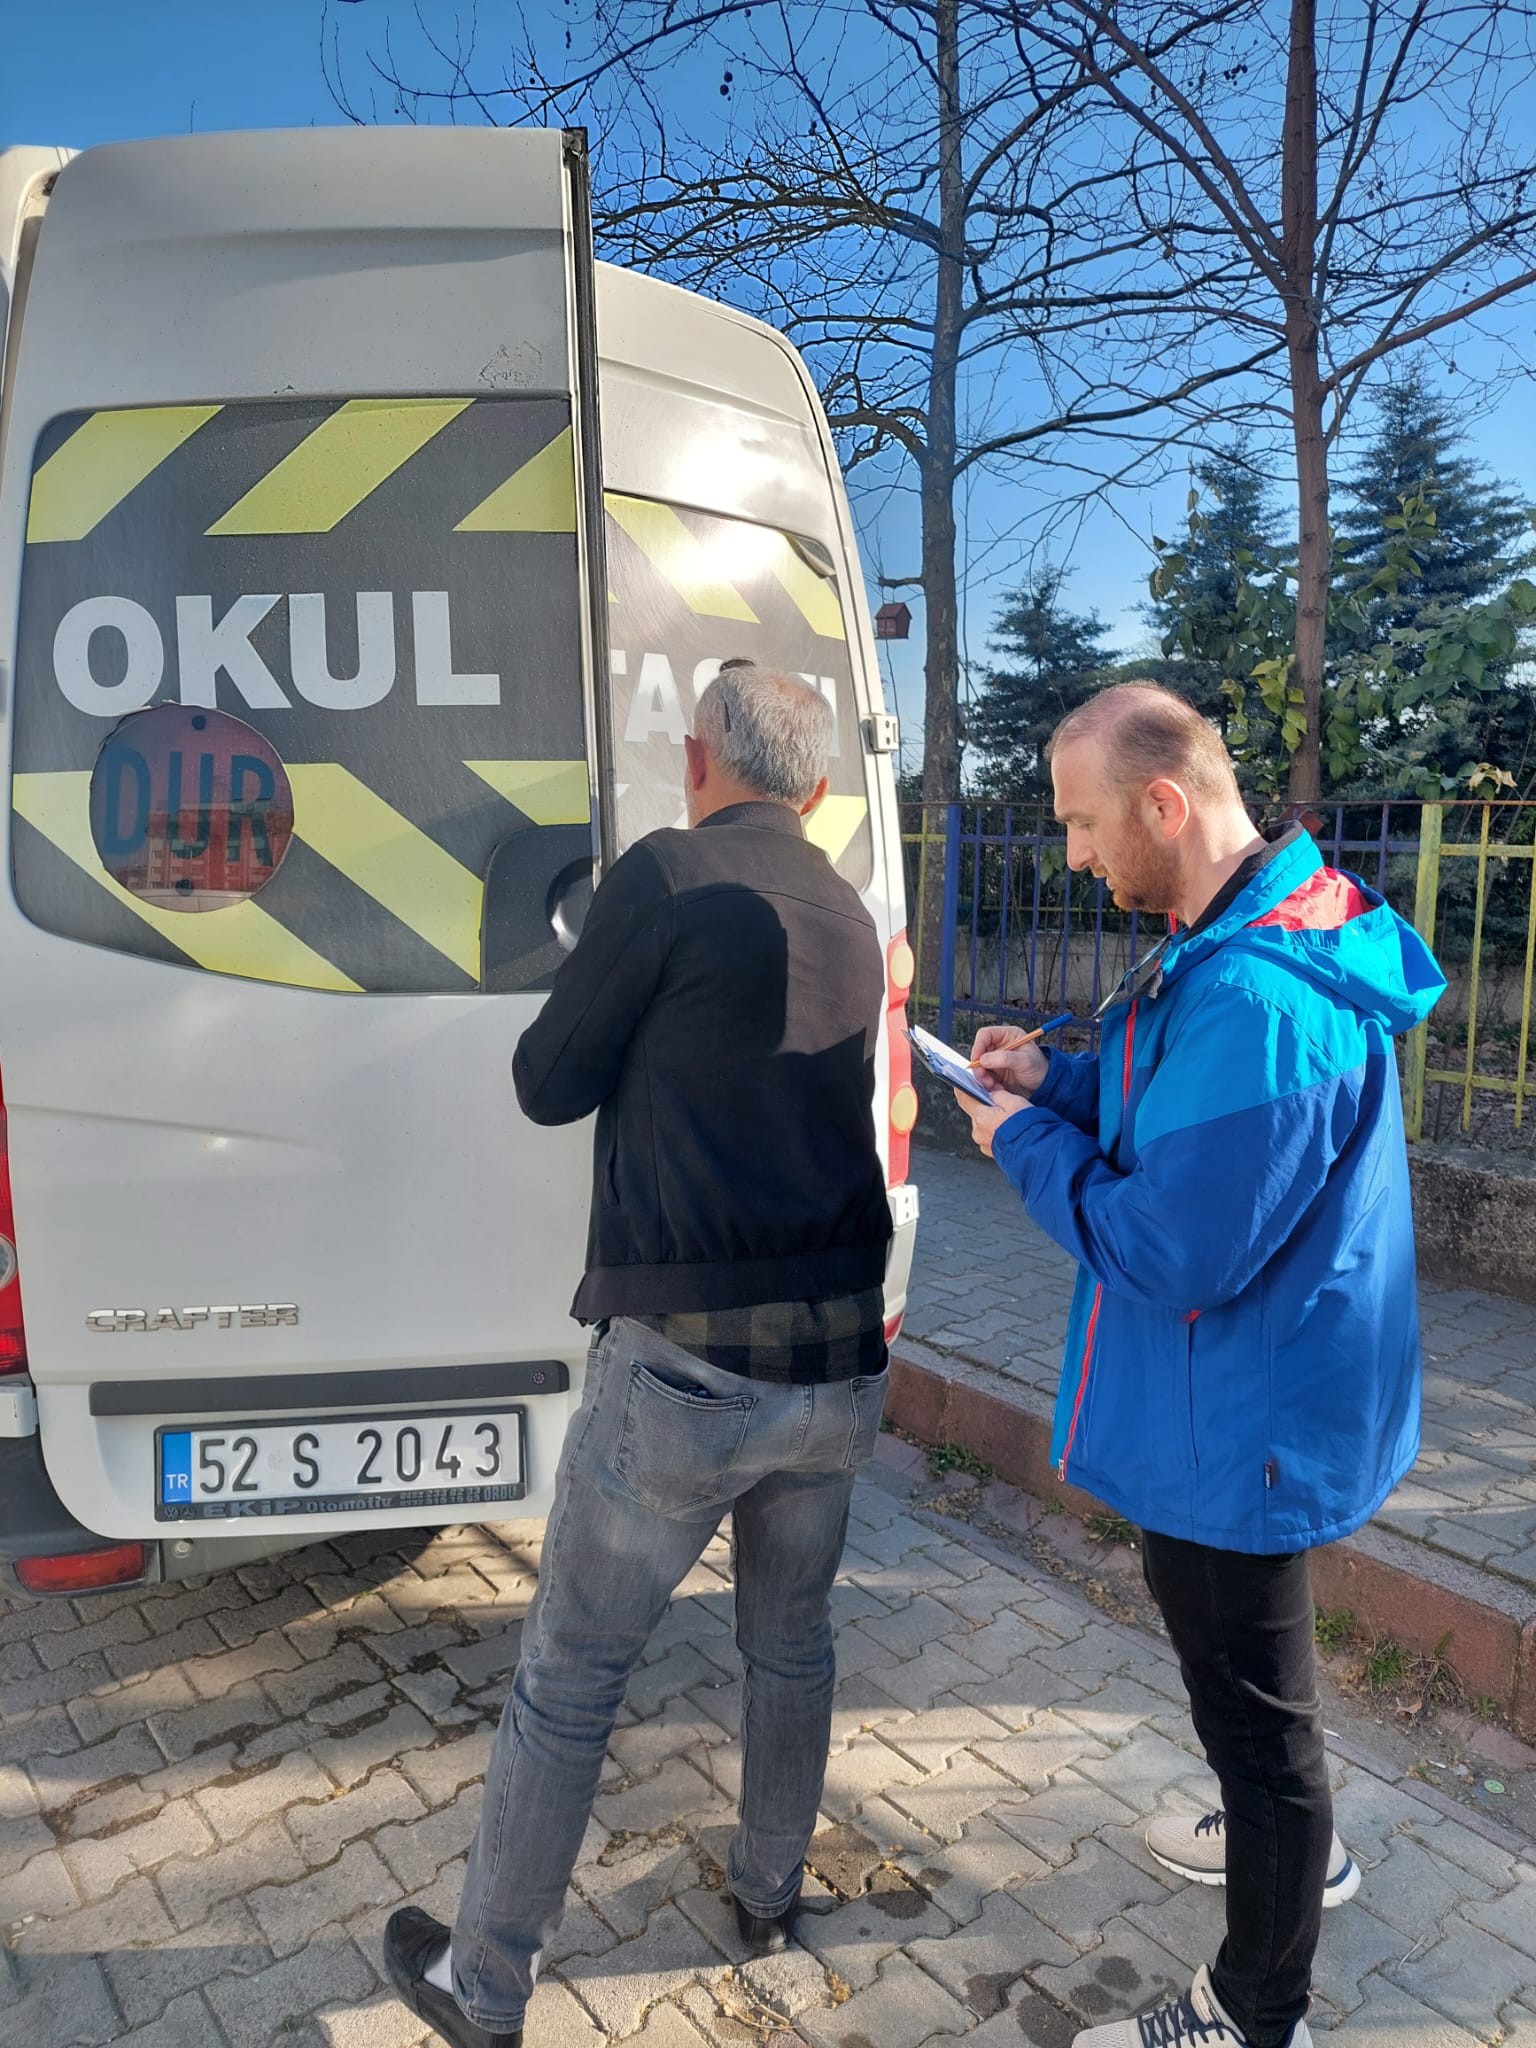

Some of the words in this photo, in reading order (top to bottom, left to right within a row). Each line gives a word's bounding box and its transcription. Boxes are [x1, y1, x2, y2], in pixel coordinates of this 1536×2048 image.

[53, 591, 500, 717] OKUL
[104, 747, 275, 866] DUR
[85, 1302, 299, 1333] CRAFTER
[167, 1474, 188, 1490] TR
[199, 1437, 258, 1494] 52
[293, 1433, 319, 1489] S
[356, 1422, 501, 1485] 2043
[306, 1497, 392, 1513] Otomotiv
